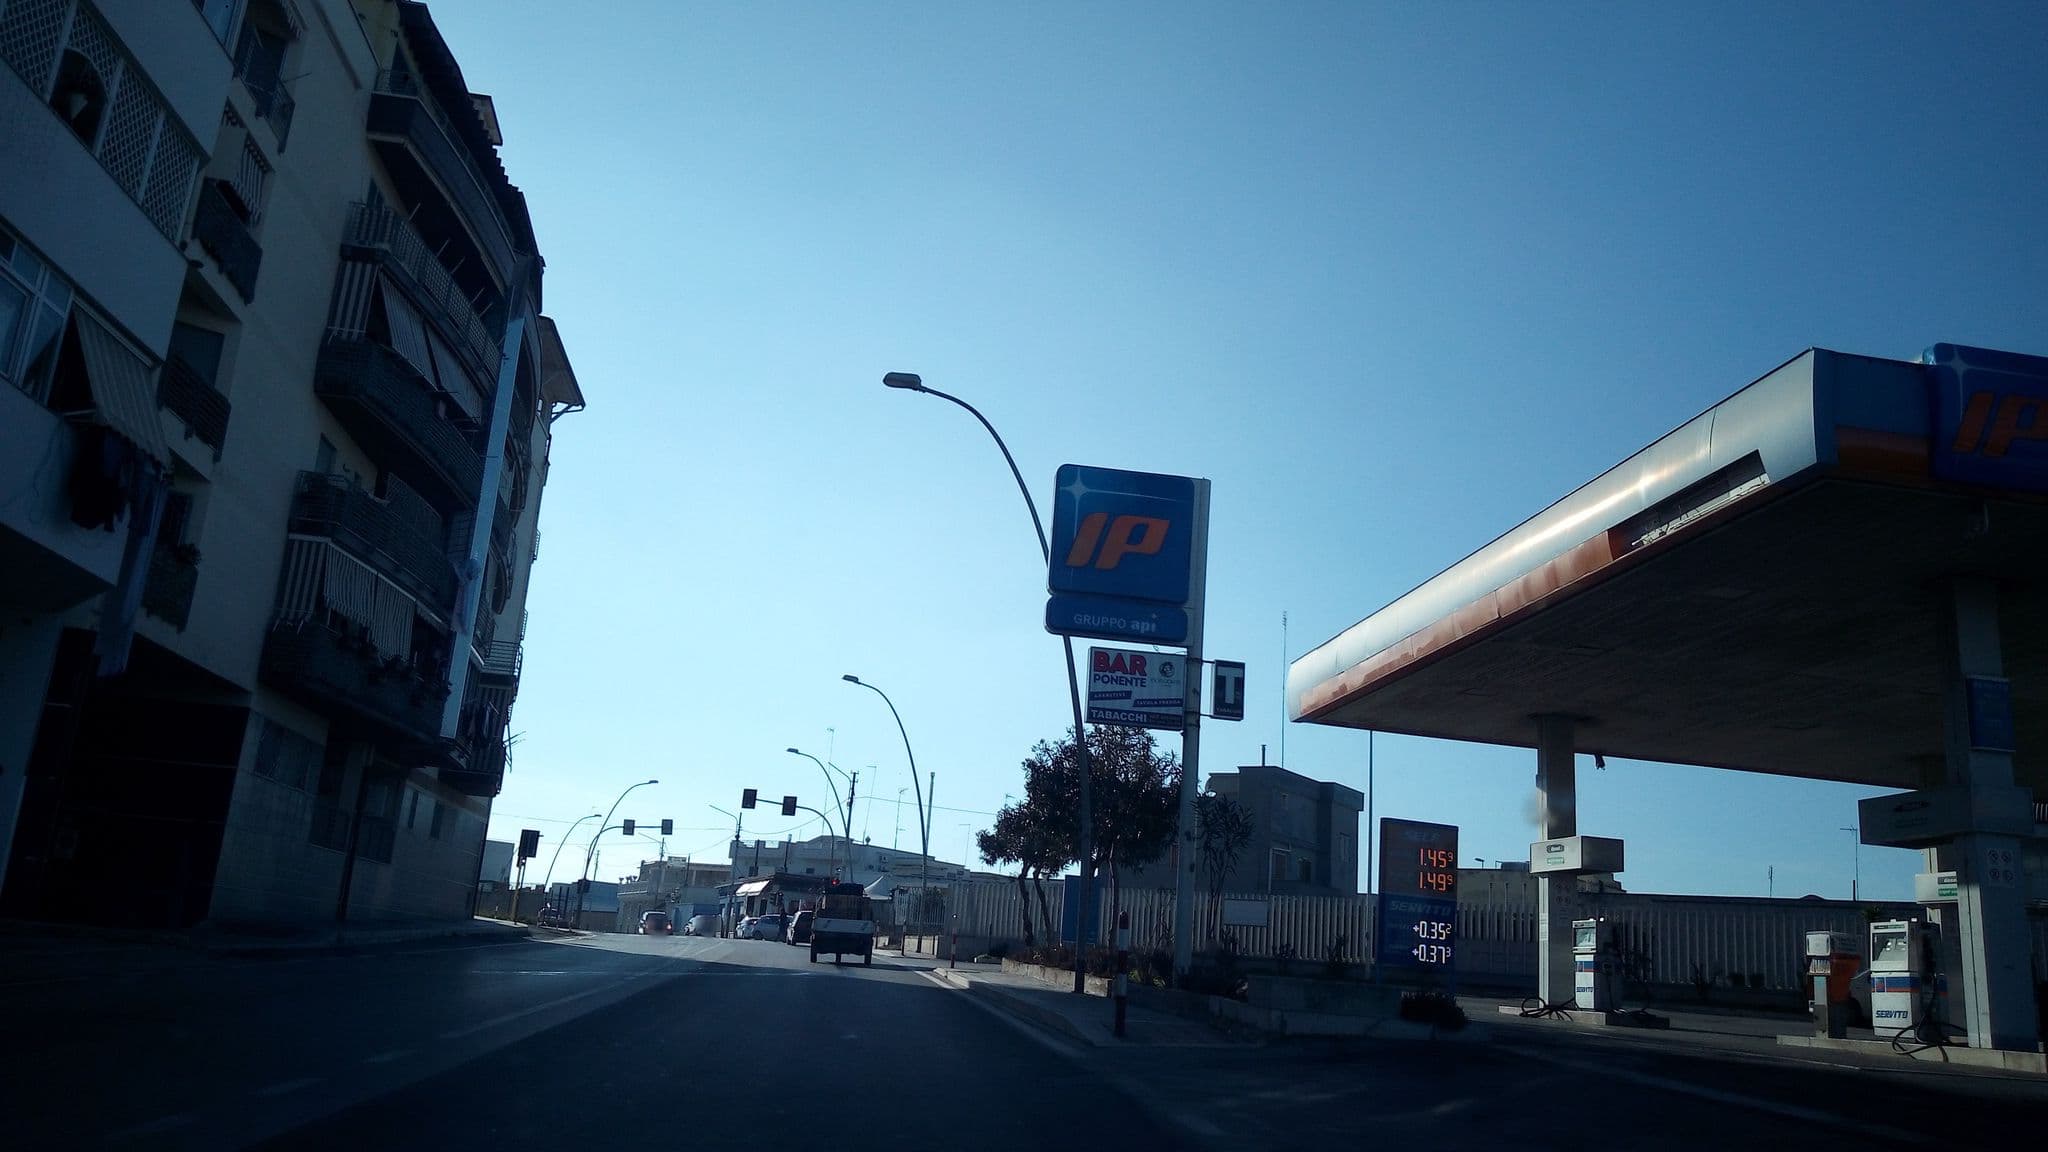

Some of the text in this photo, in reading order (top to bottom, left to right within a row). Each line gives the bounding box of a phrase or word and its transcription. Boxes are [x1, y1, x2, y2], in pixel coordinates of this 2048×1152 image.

[1066, 512, 1170, 570] IP
[1073, 613, 1157, 634] GRUPPO api
[1093, 651, 1147, 676] BAR
[1094, 674, 1147, 688] PONENTE
[1217, 666, 1242, 704] T
[1091, 709, 1147, 723] TABACCHI
[1391, 900, 1451, 915] SERVITO
[1876, 1010, 1908, 1019] SERVITO
